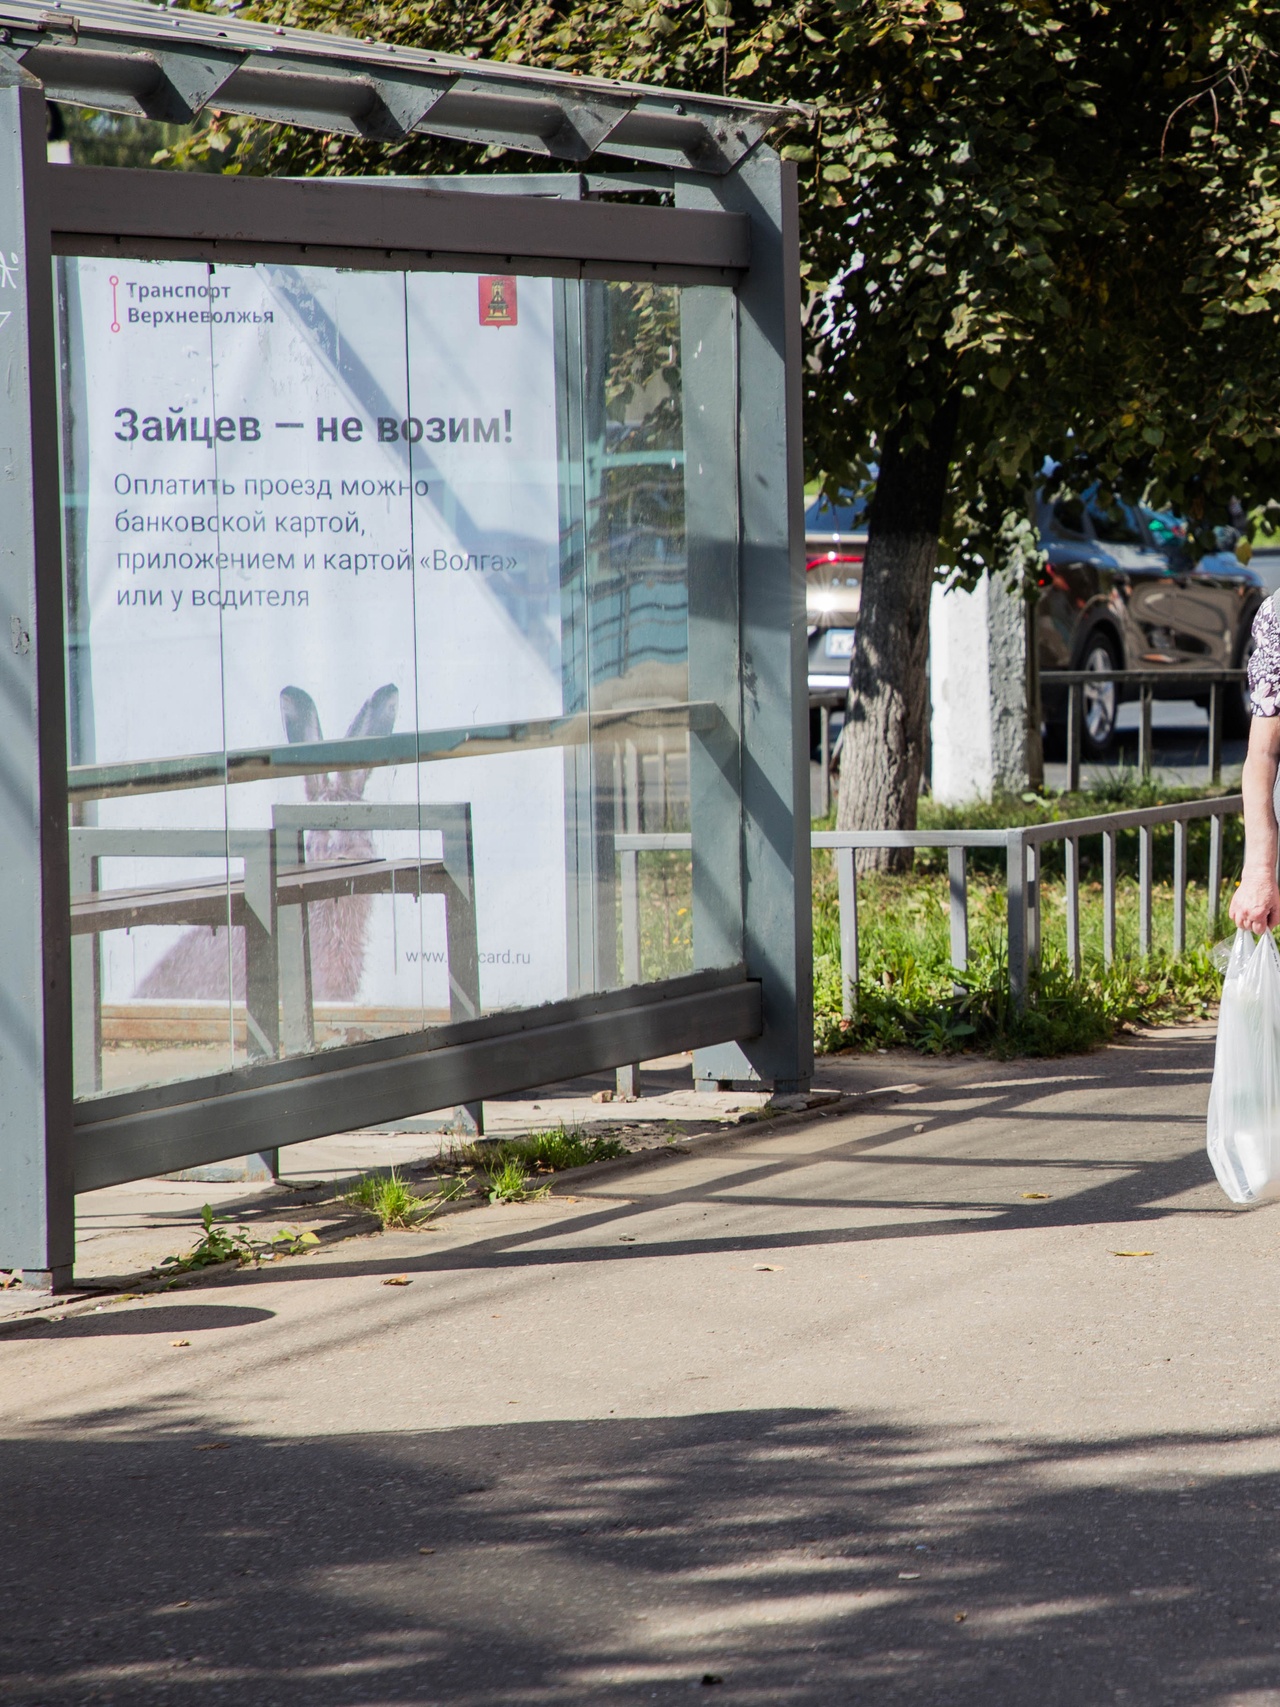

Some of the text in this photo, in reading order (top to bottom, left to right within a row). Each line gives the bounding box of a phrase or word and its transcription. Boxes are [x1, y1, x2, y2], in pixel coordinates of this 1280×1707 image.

[126, 282, 231, 303] Транспорт
[128, 307, 275, 327] Верхневолжья
[114, 406, 262, 449] Зайцев
[316, 416, 363, 443] не
[376, 408, 513, 444] возим!
[114, 473, 429, 501] Оплатить проезд можно
[115, 509, 366, 539] банковской картой,
[117, 548, 518, 576] приложением и картой «Волга»
[117, 589, 310, 612] или у водителя
